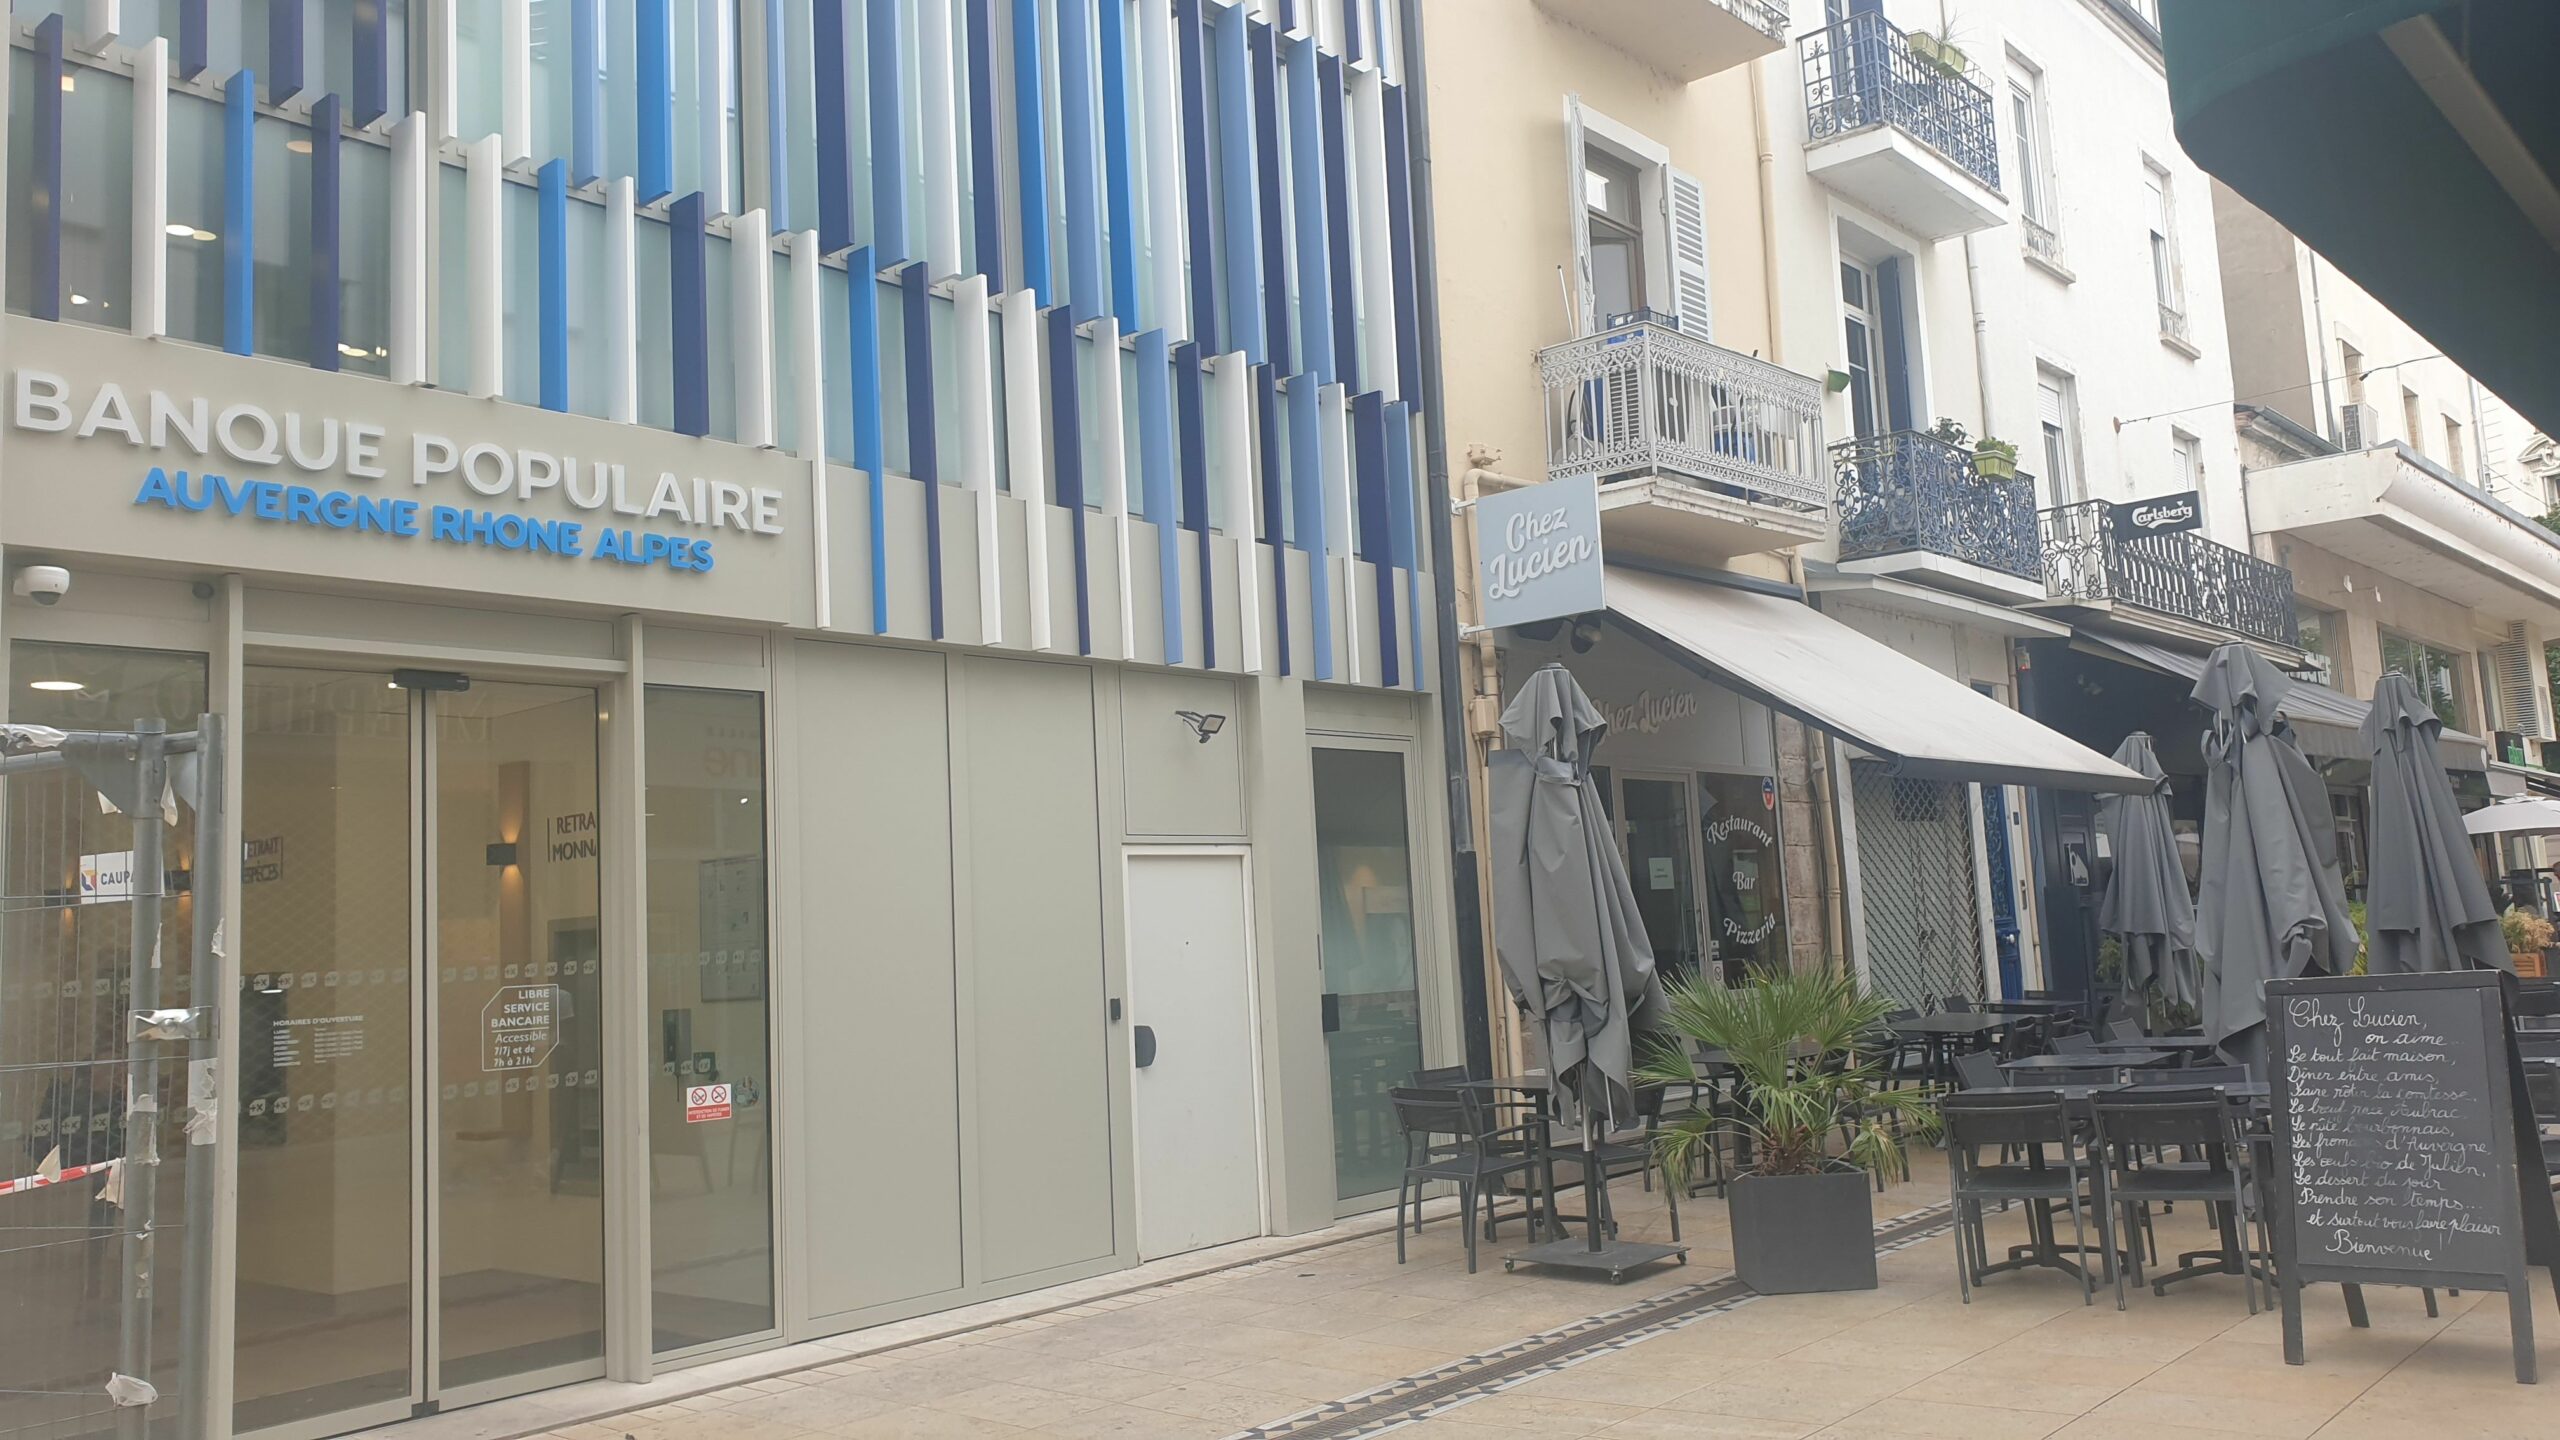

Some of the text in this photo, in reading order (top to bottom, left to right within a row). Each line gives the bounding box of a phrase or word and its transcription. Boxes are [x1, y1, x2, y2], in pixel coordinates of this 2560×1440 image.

[13, 368, 785, 536] BANQUE POPULAIRE
[134, 466, 715, 573] AUVERGNE RHONE ALPES
[2132, 501, 2193, 529] Carlsberg
[1506, 507, 1568, 552] Chez
[1489, 535, 1592, 599] Lucien
[1640, 689, 1697, 734] Lucien
[1707, 814, 1773, 848] Restaurant
[552, 838, 597, 862] MONN
[1733, 871, 1755, 890] Bar
[1724, 912, 1776, 945] Pizzeria
[518, 989, 550, 1000] LIBRE
[504, 1002, 550, 1014] SERVICE
[491, 1015, 550, 1028] BANCAIRE
[2289, 997, 2344, 1047] Chez
[495, 1031, 547, 1043] Accessible
[2365, 1033, 2389, 1045] on
[512, 1047, 522, 1055] et
[524, 1044, 536, 1054] de
[2287, 1045, 2307, 1063] Le
[2310, 1047, 2344, 1062] tout
[2349, 1048, 2379, 1069] fait
[494, 1057, 505, 1067] 7h
[516, 1055, 532, 1066] 21h
[2337, 1068, 2379, 1082] entre
[2288, 1098, 2305, 1114] Le
[2292, 1151, 2316, 1168] Les
[2395, 1153, 2416, 1171] de
[2294, 1169, 2312, 1186] Le
[2315, 1170, 2368, 1187] dessert
[2374, 1173, 2398, 1187] du
[2298, 1187, 2358, 1205] Prendre
[2363, 1195, 2397, 1206] son
[2306, 1208, 2324, 1227] et
[2327, 1210, 2382, 1228] surtout
[2325, 1228, 2433, 1261] Bienvenue
